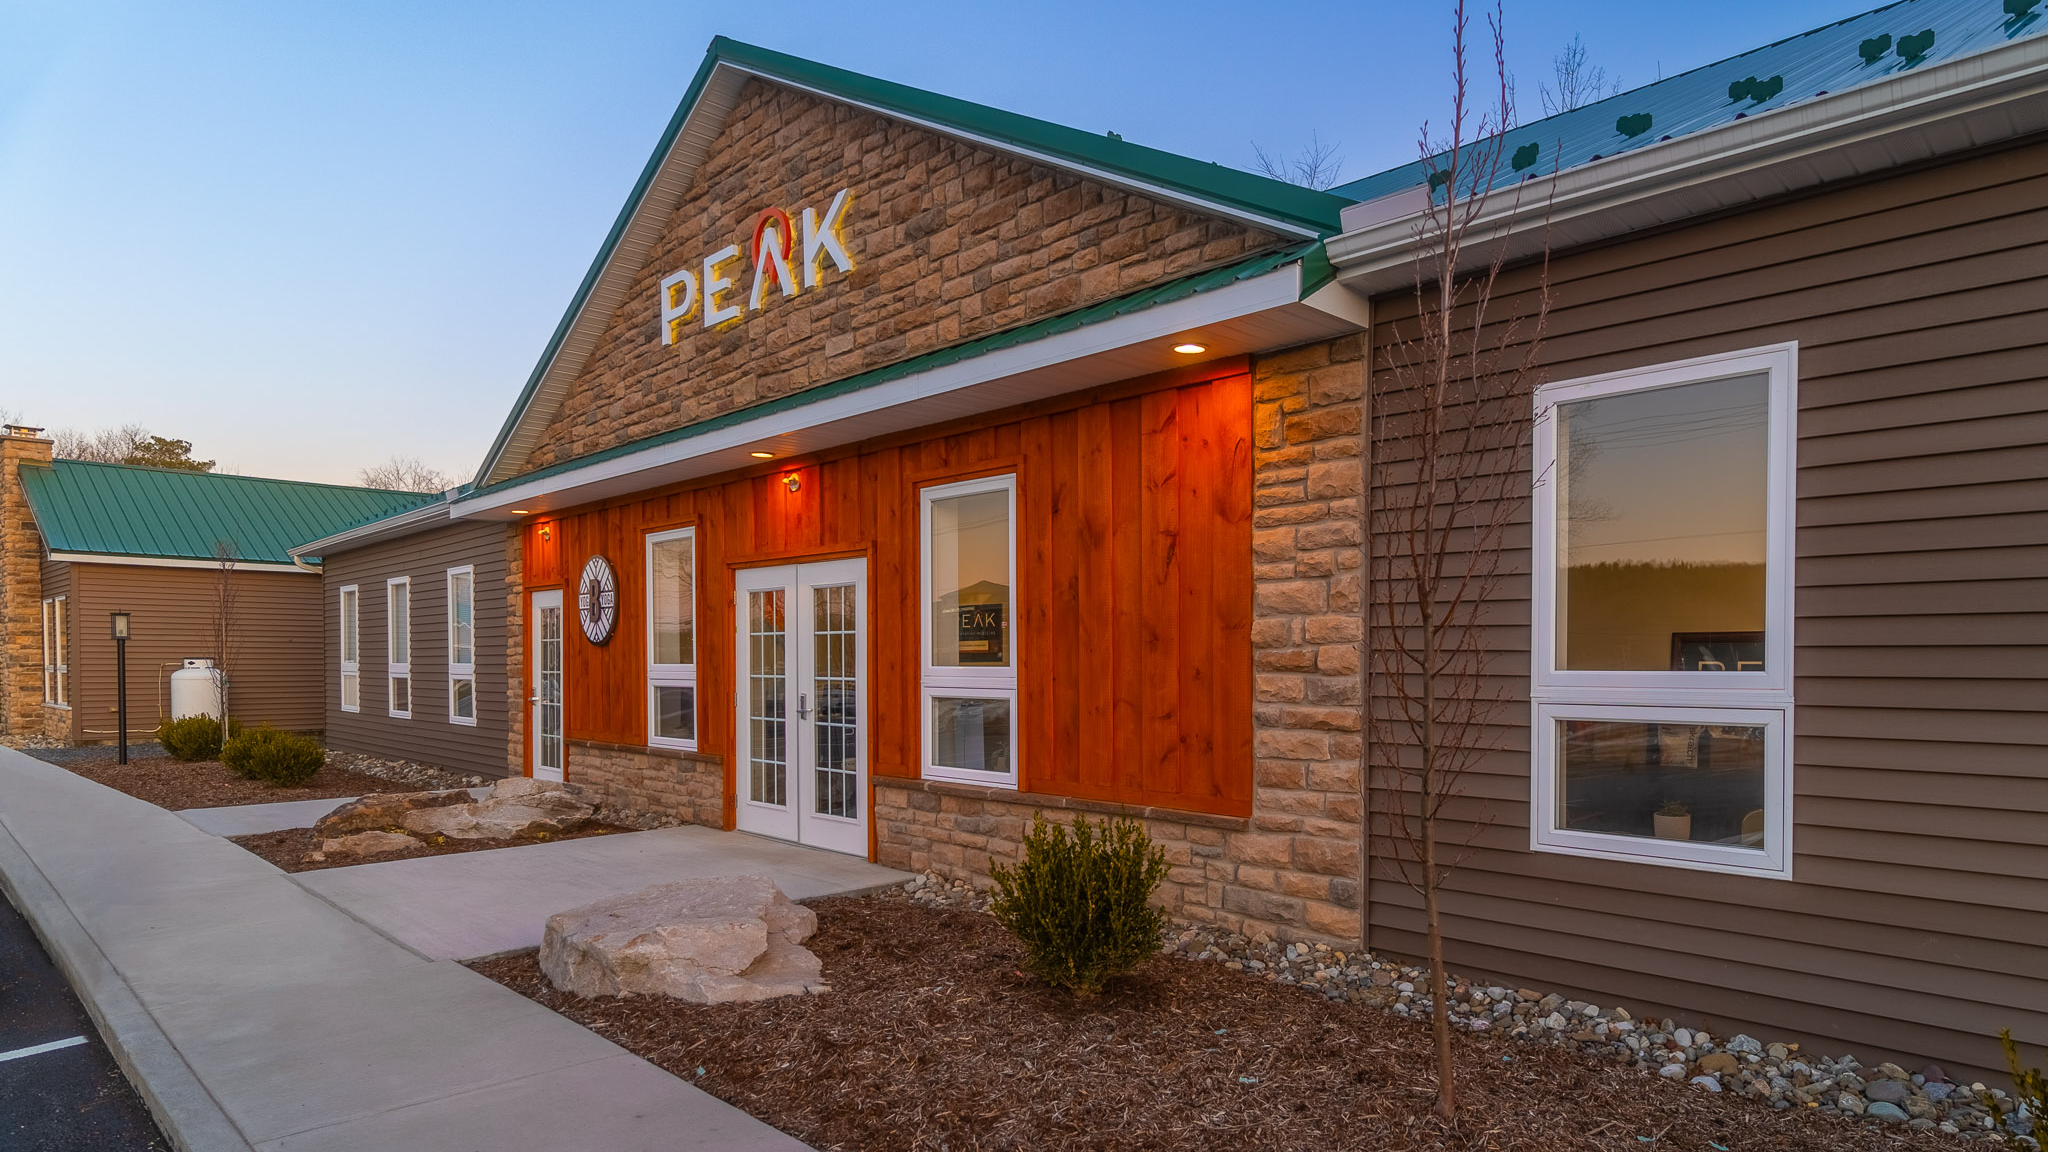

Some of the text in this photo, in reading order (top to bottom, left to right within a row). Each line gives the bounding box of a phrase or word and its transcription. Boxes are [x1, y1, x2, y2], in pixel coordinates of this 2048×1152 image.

[661, 188, 853, 346] PEAK
[580, 595, 590, 607] YOG
[589, 579, 600, 622] B
[601, 593, 613, 606] YOGA
[962, 612, 996, 628] EAK
